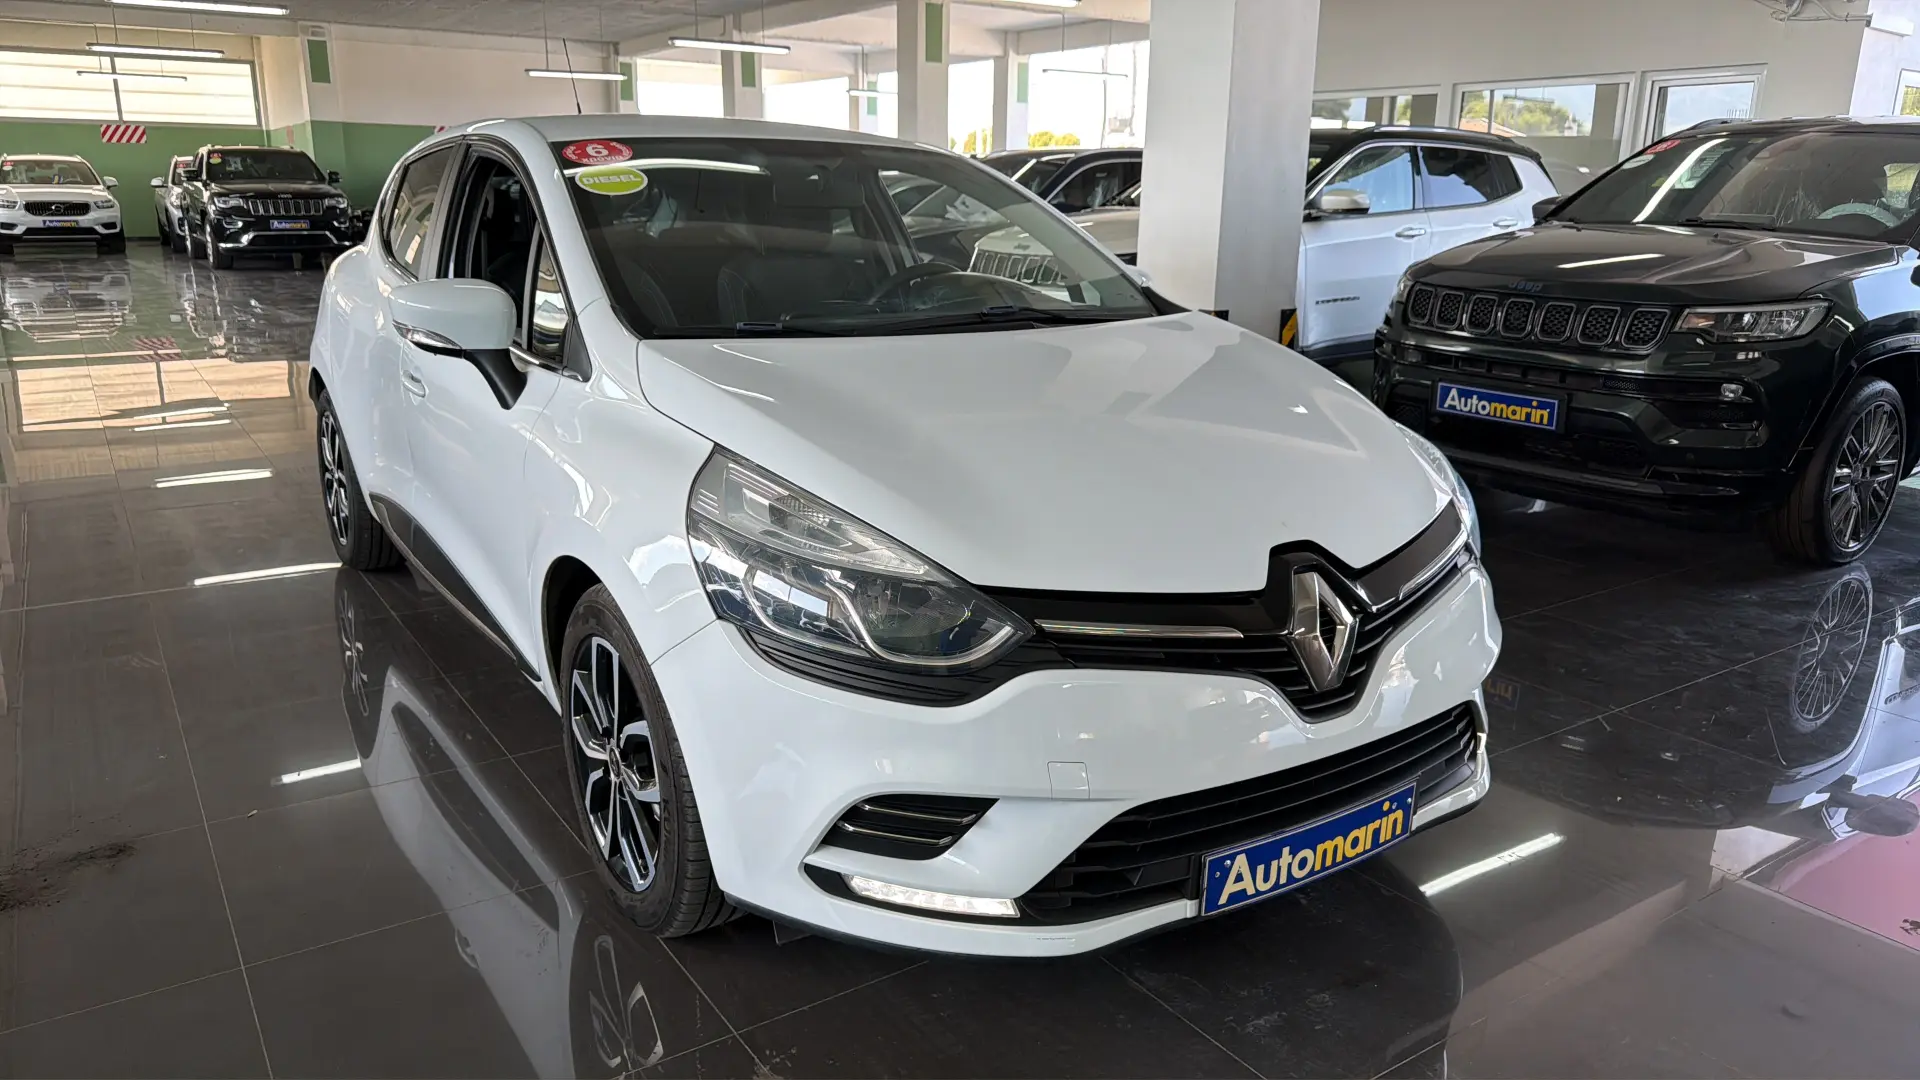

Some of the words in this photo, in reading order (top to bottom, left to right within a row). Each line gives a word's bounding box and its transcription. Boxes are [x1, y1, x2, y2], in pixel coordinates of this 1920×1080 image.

[586, 144, 609, 157] 6
[582, 174, 641, 184] DIESEL
[273, 221, 308, 229] Automarin
[1443, 387, 1550, 425] Automarin
[1217, 800, 1404, 906] Automarin
